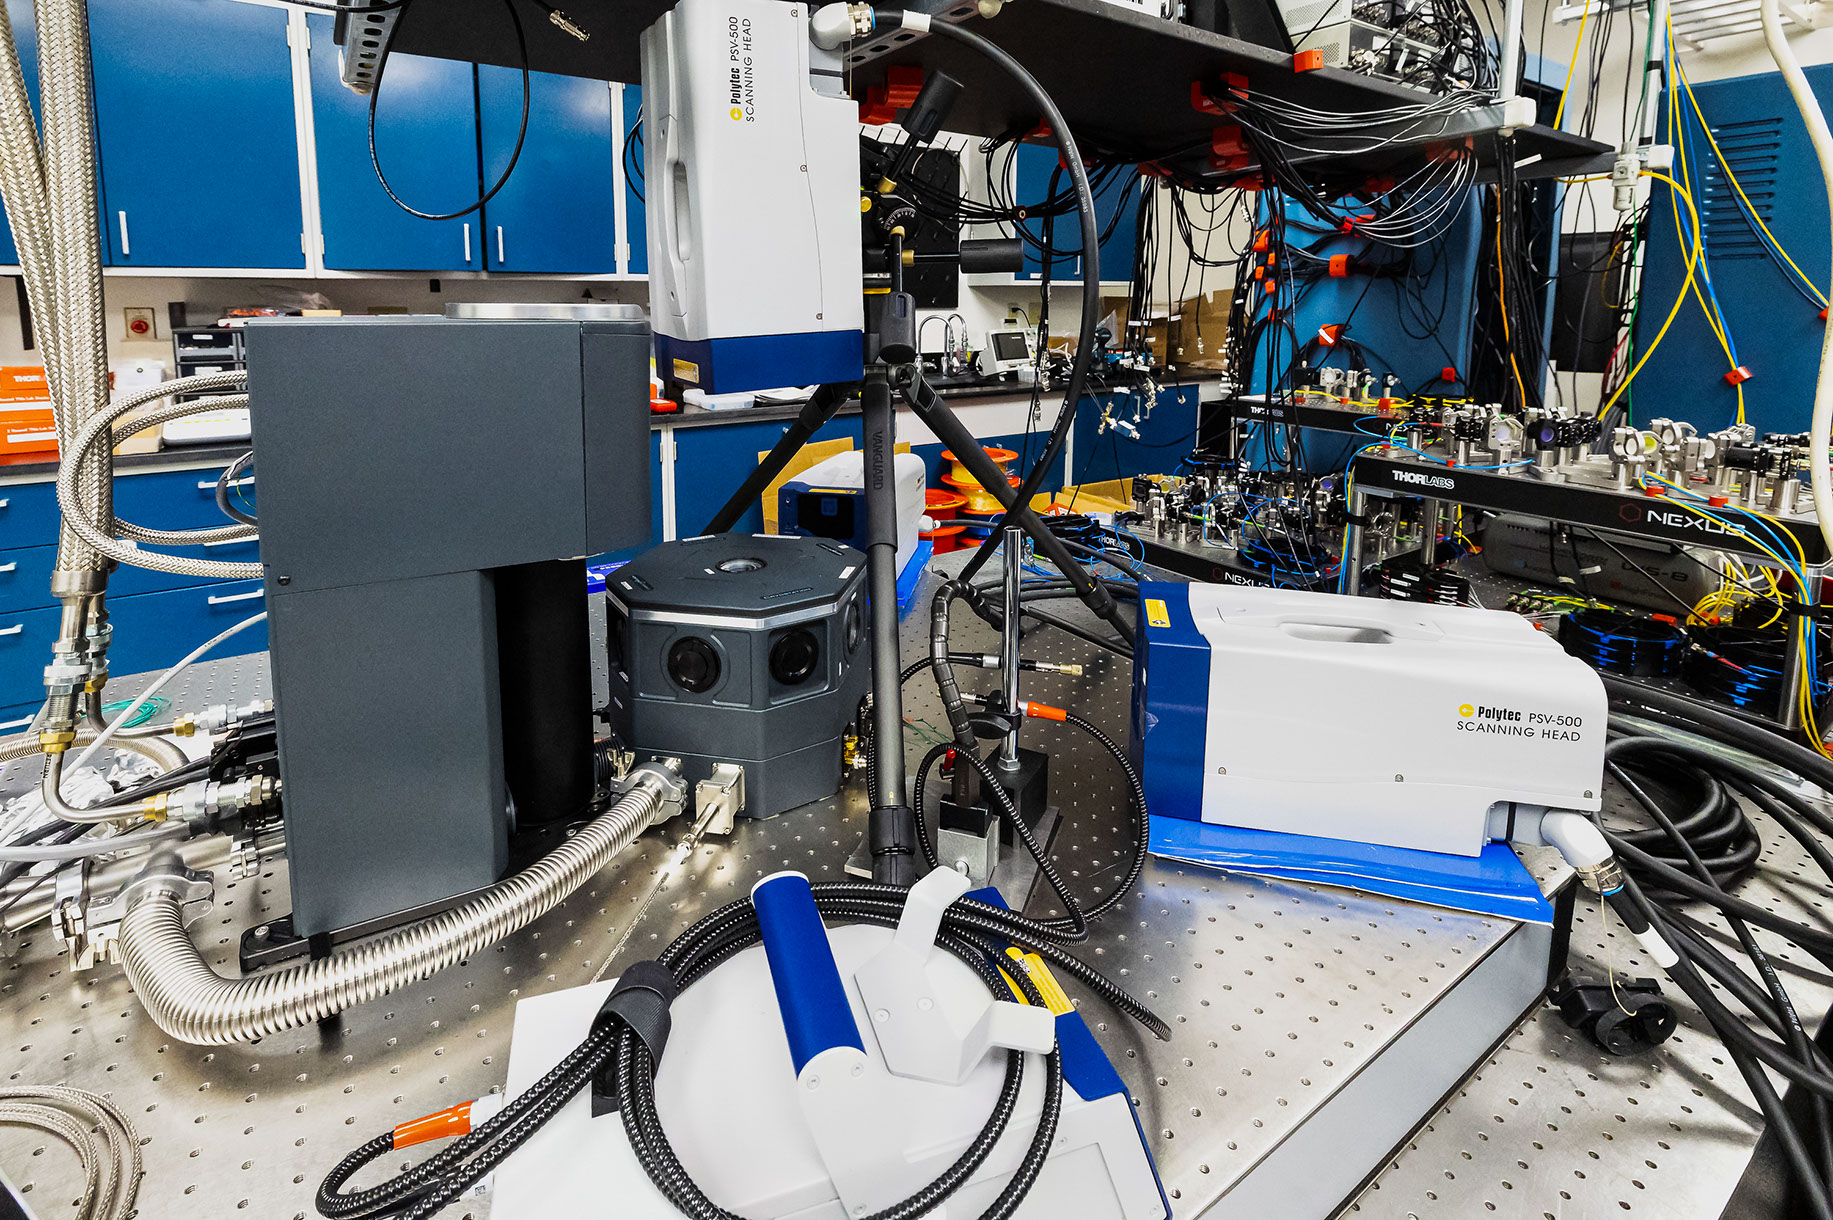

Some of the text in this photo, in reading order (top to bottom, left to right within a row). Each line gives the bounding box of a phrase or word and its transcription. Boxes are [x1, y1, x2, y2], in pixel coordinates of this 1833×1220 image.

[729, 16, 742, 104] Polytec PSV-500
[742, 18, 755, 122] SCANNING HEAD
[872, 430, 884, 491] VANGUARD
[1392, 470, 1454, 489] THORLABS
[1457, 720, 1581, 742] SCANNING HEAD
[1478, 706, 1583, 727] Polytec PSV-500
